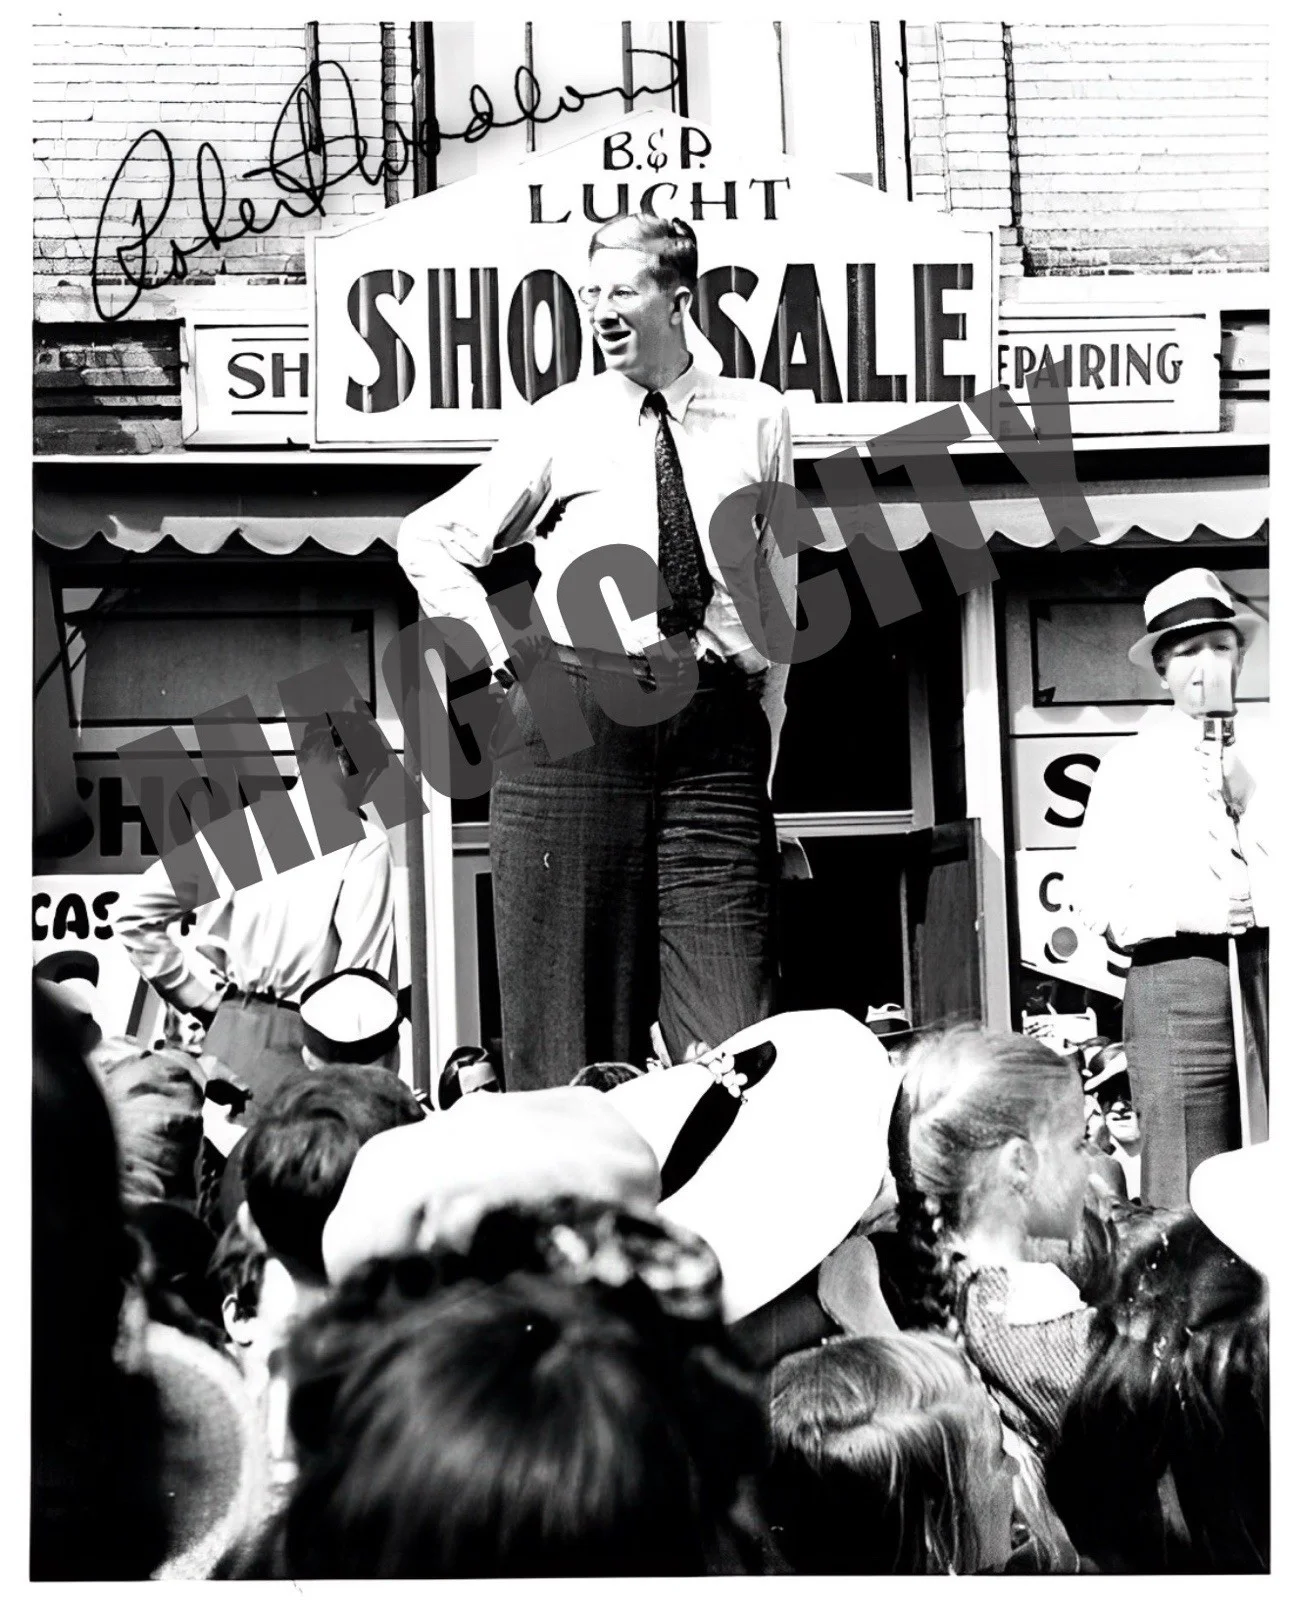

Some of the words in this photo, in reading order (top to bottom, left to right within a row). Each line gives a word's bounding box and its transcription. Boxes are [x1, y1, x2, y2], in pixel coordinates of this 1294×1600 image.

[528, 177, 791, 224] LUCHT
[345, 267, 606, 414] SHO
[688, 263, 976, 404] SALE
